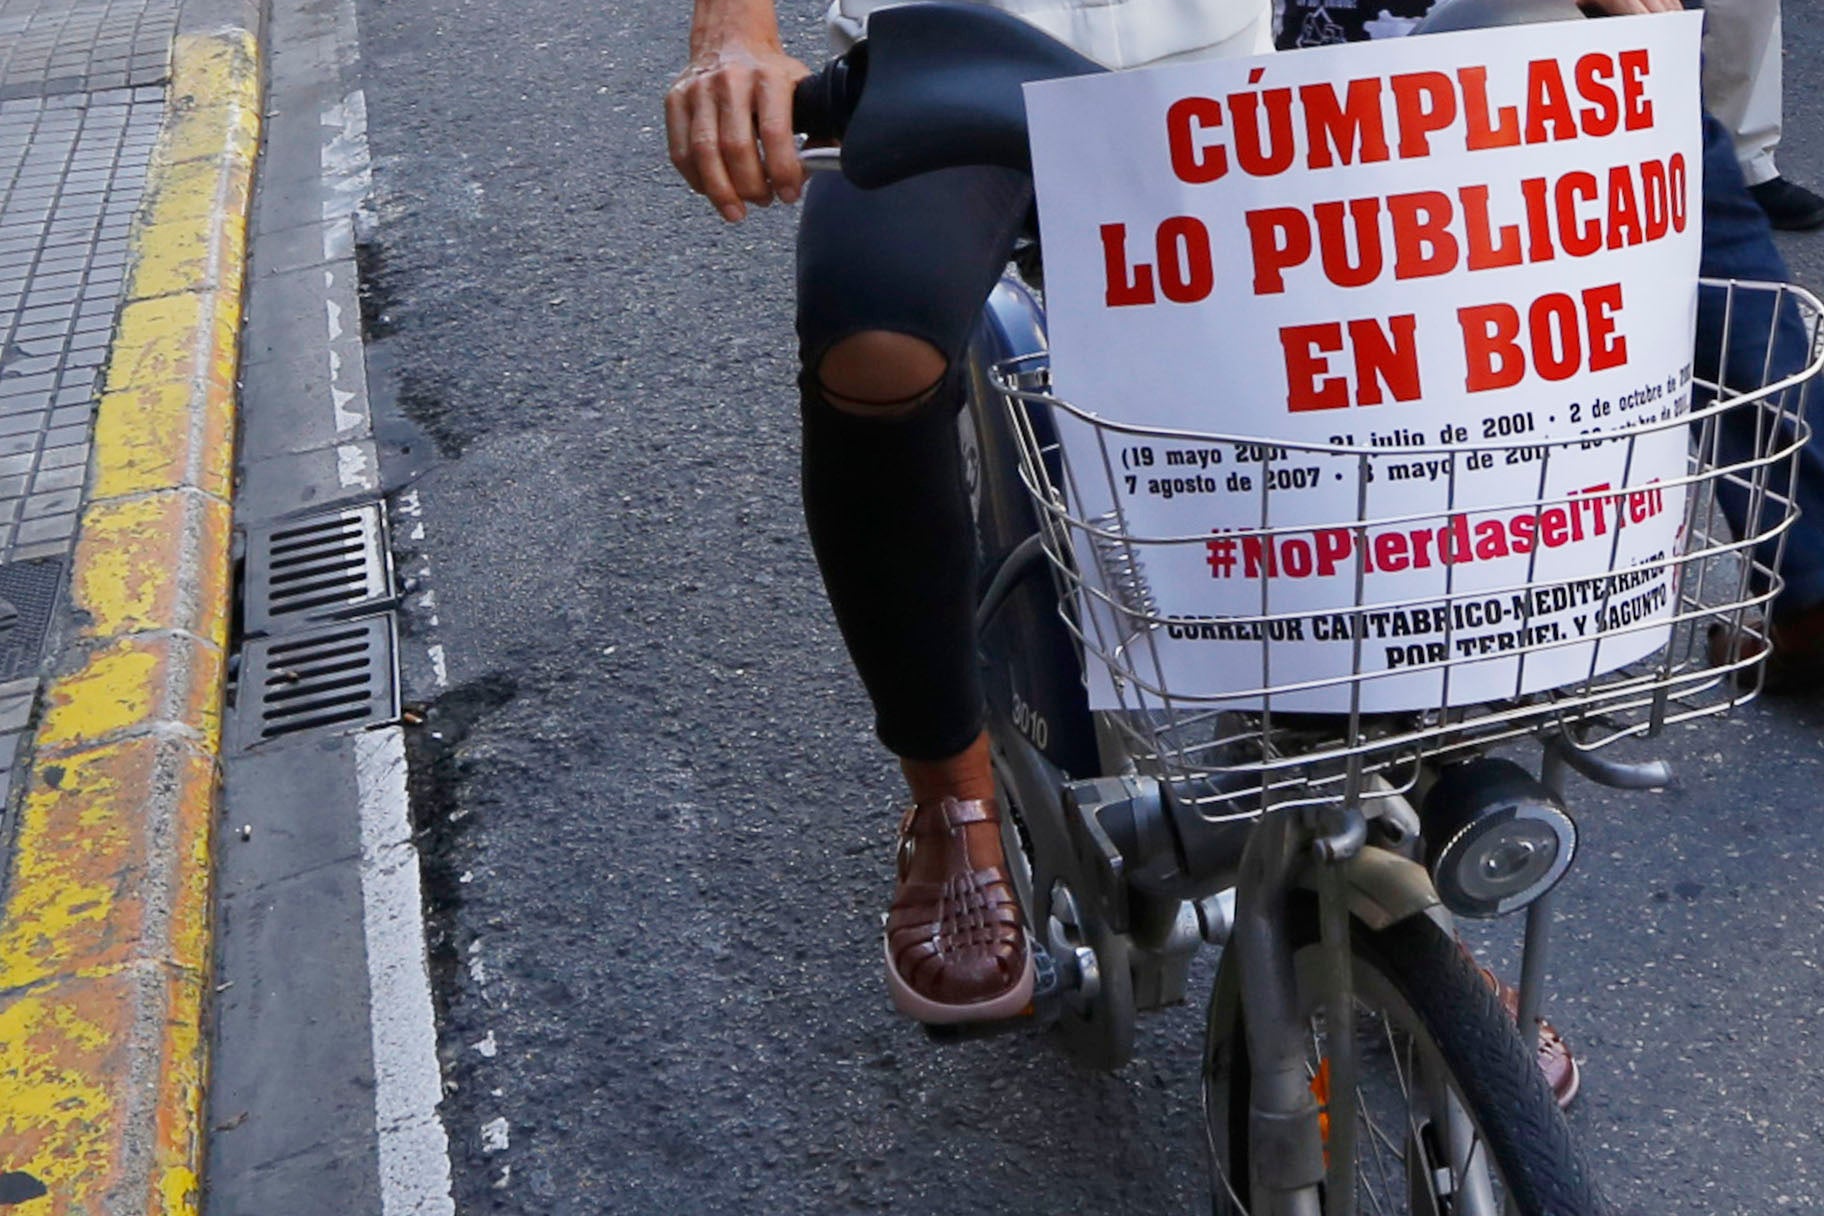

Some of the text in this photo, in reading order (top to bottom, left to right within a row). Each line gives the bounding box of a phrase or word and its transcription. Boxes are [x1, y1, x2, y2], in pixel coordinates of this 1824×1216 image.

[1165, 48, 1654, 184] CÚMPLASE
[1100, 152, 1686, 308] LO PUBLICADO
[1278, 283, 1629, 414] EN BOE
[1121, 446, 1155, 471] (19
[1166, 446, 1223, 470] mayo
[1440, 423, 1469, 445] de
[1482, 411, 1535, 440] 2001
[1569, 402, 1582, 424] 2
[1592, 397, 1612, 419] de
[1618, 383, 1662, 412] octubre
[1124, 475, 1138, 495] 7
[1148, 473, 1217, 500] agosto
[1226, 471, 1253, 492] de
[1466, 448, 1494, 471] de
[1573, 615, 1588, 637] Y
